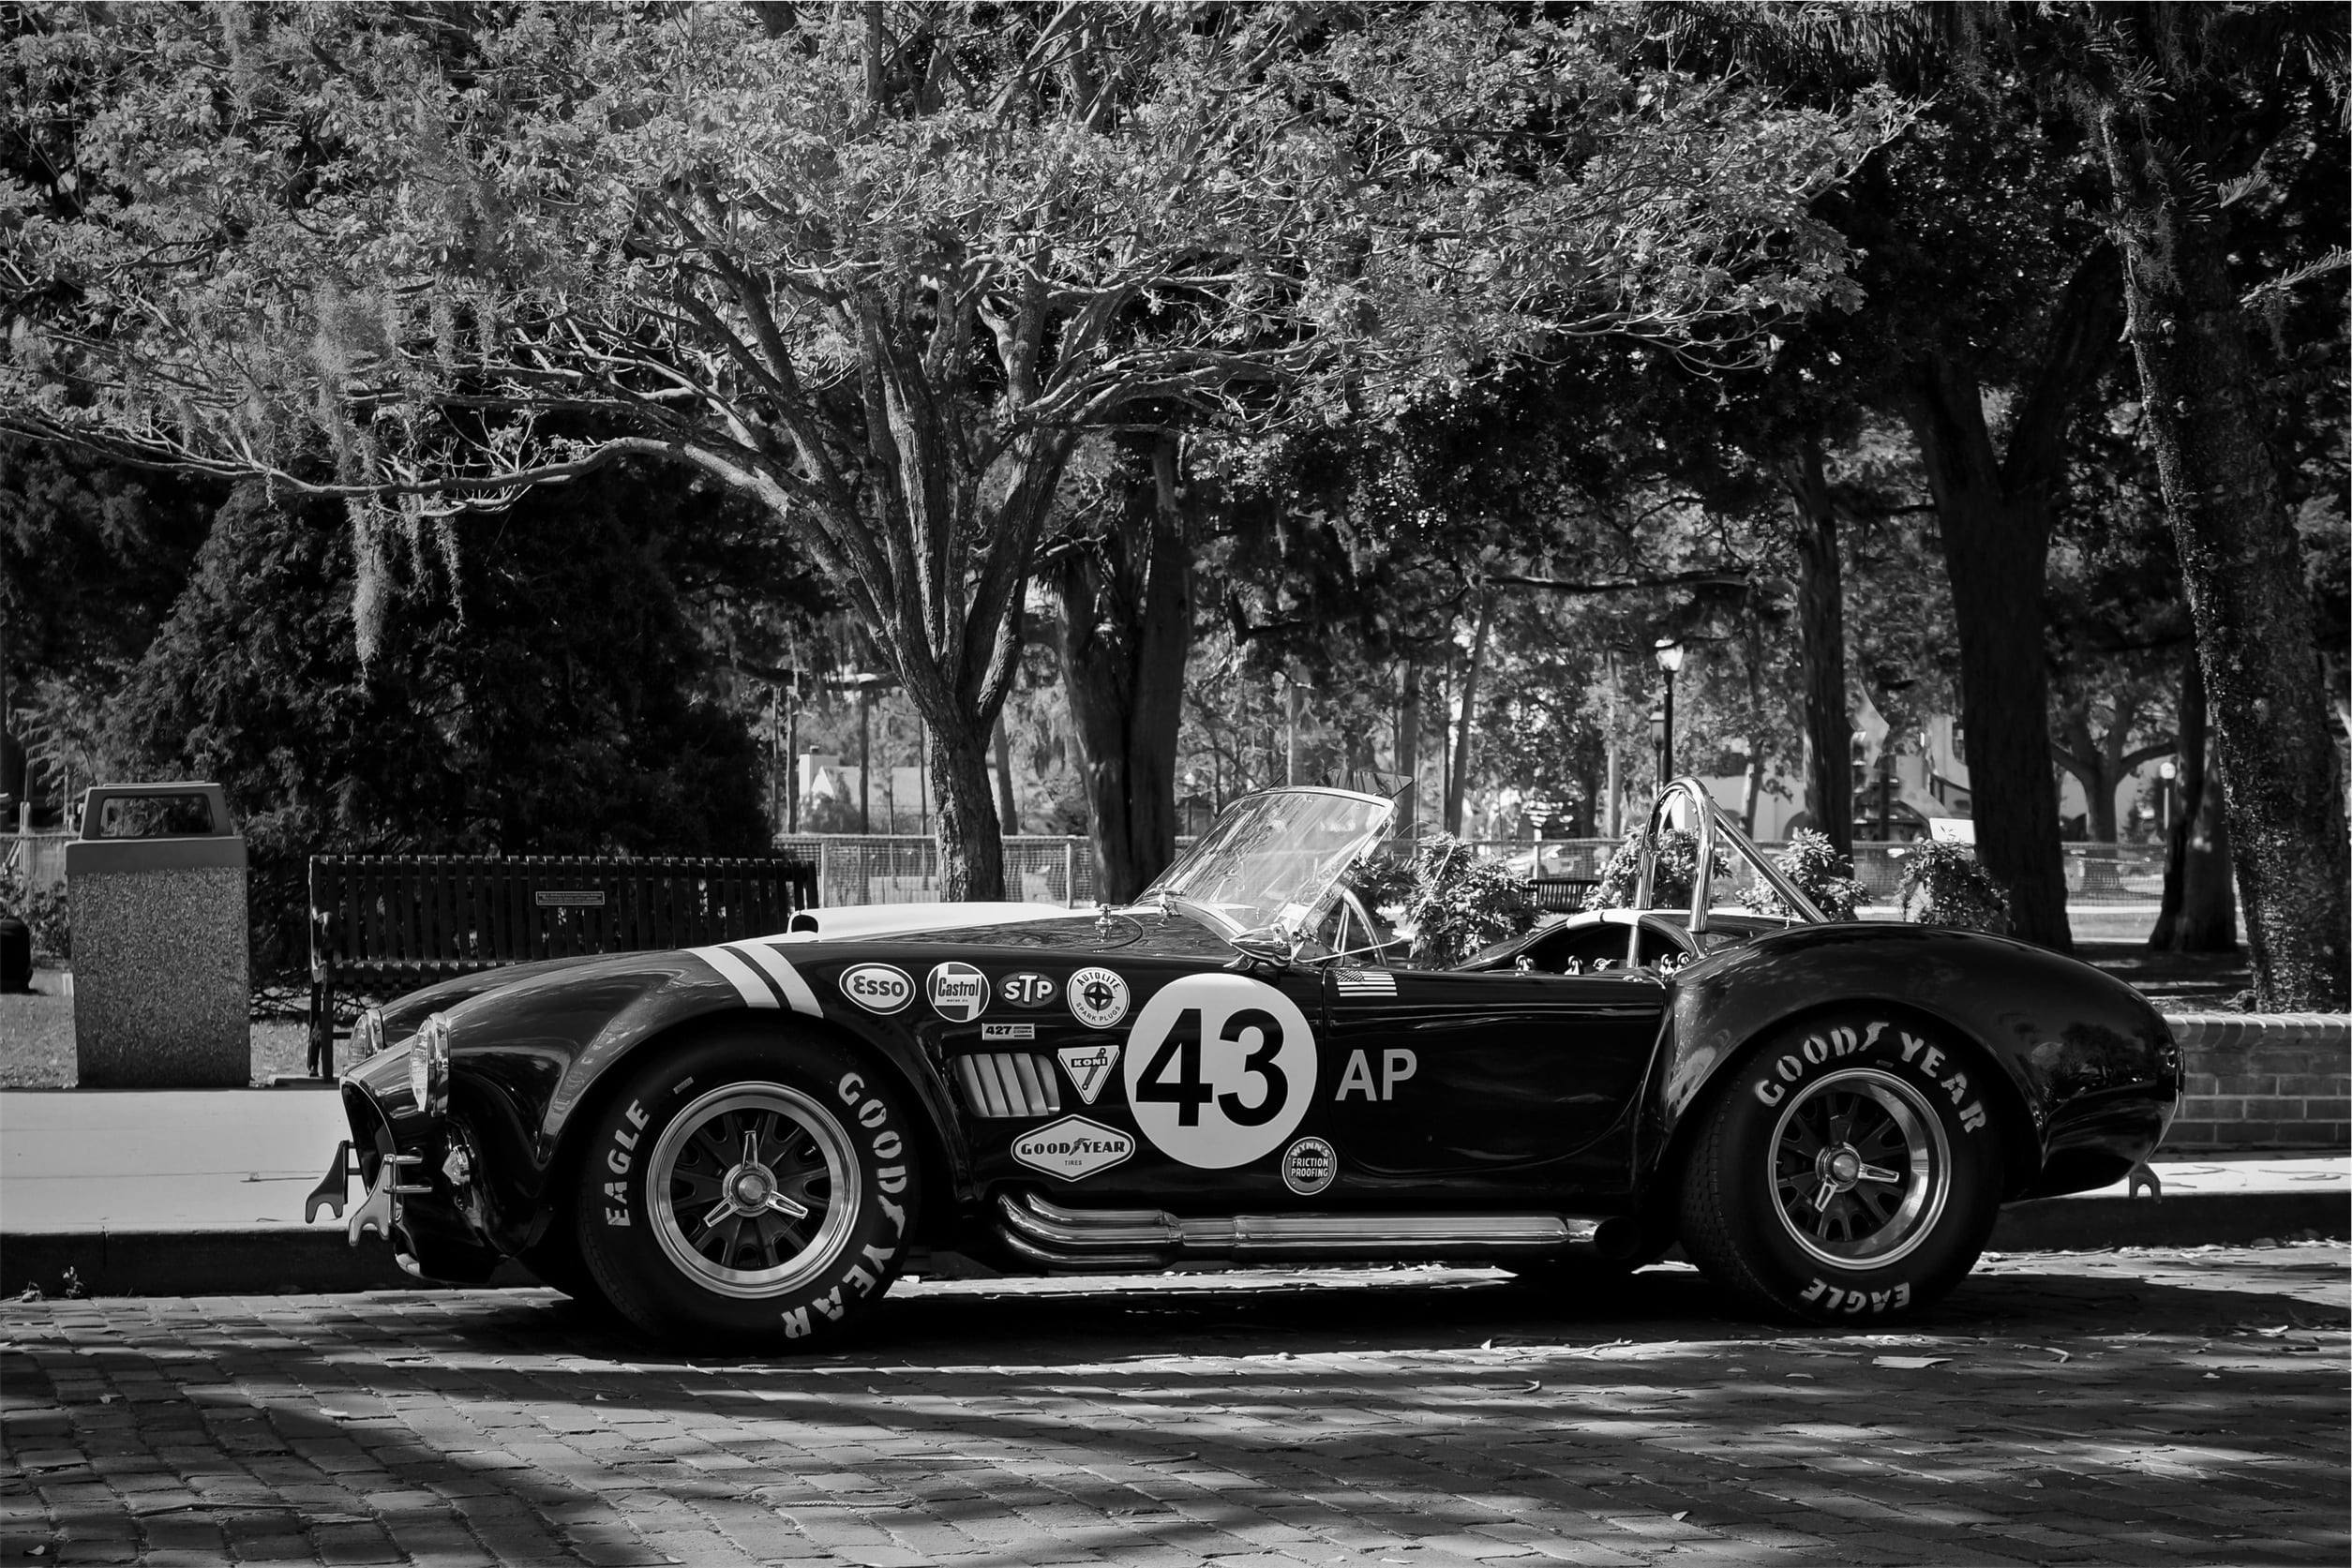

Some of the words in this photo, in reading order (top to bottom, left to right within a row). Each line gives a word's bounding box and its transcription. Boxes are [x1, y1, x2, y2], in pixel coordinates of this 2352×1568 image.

[938, 977, 980, 997] Castrol
[1004, 975, 1053, 1002] STP
[1076, 971, 1121, 991] AUTOLITE
[1076, 1002, 1097, 1022] SPARK
[1099, 1005, 1121, 1022] PLUGS
[985, 1025, 1012, 1035] 427
[1073, 1058, 1106, 1067] KONI
[1135, 1008, 1289, 1127] 43
[1335, 1048, 1417, 1101] AP
[1291, 1142, 1331, 1157] WYNN'S
[605, 1099, 651, 1226] EAGLE
[1292, 1157, 1328, 1167] FRICTION
[1291, 1168, 1328, 1177] PROOFING
[1801, 1277, 1910, 1312] EAGLE
